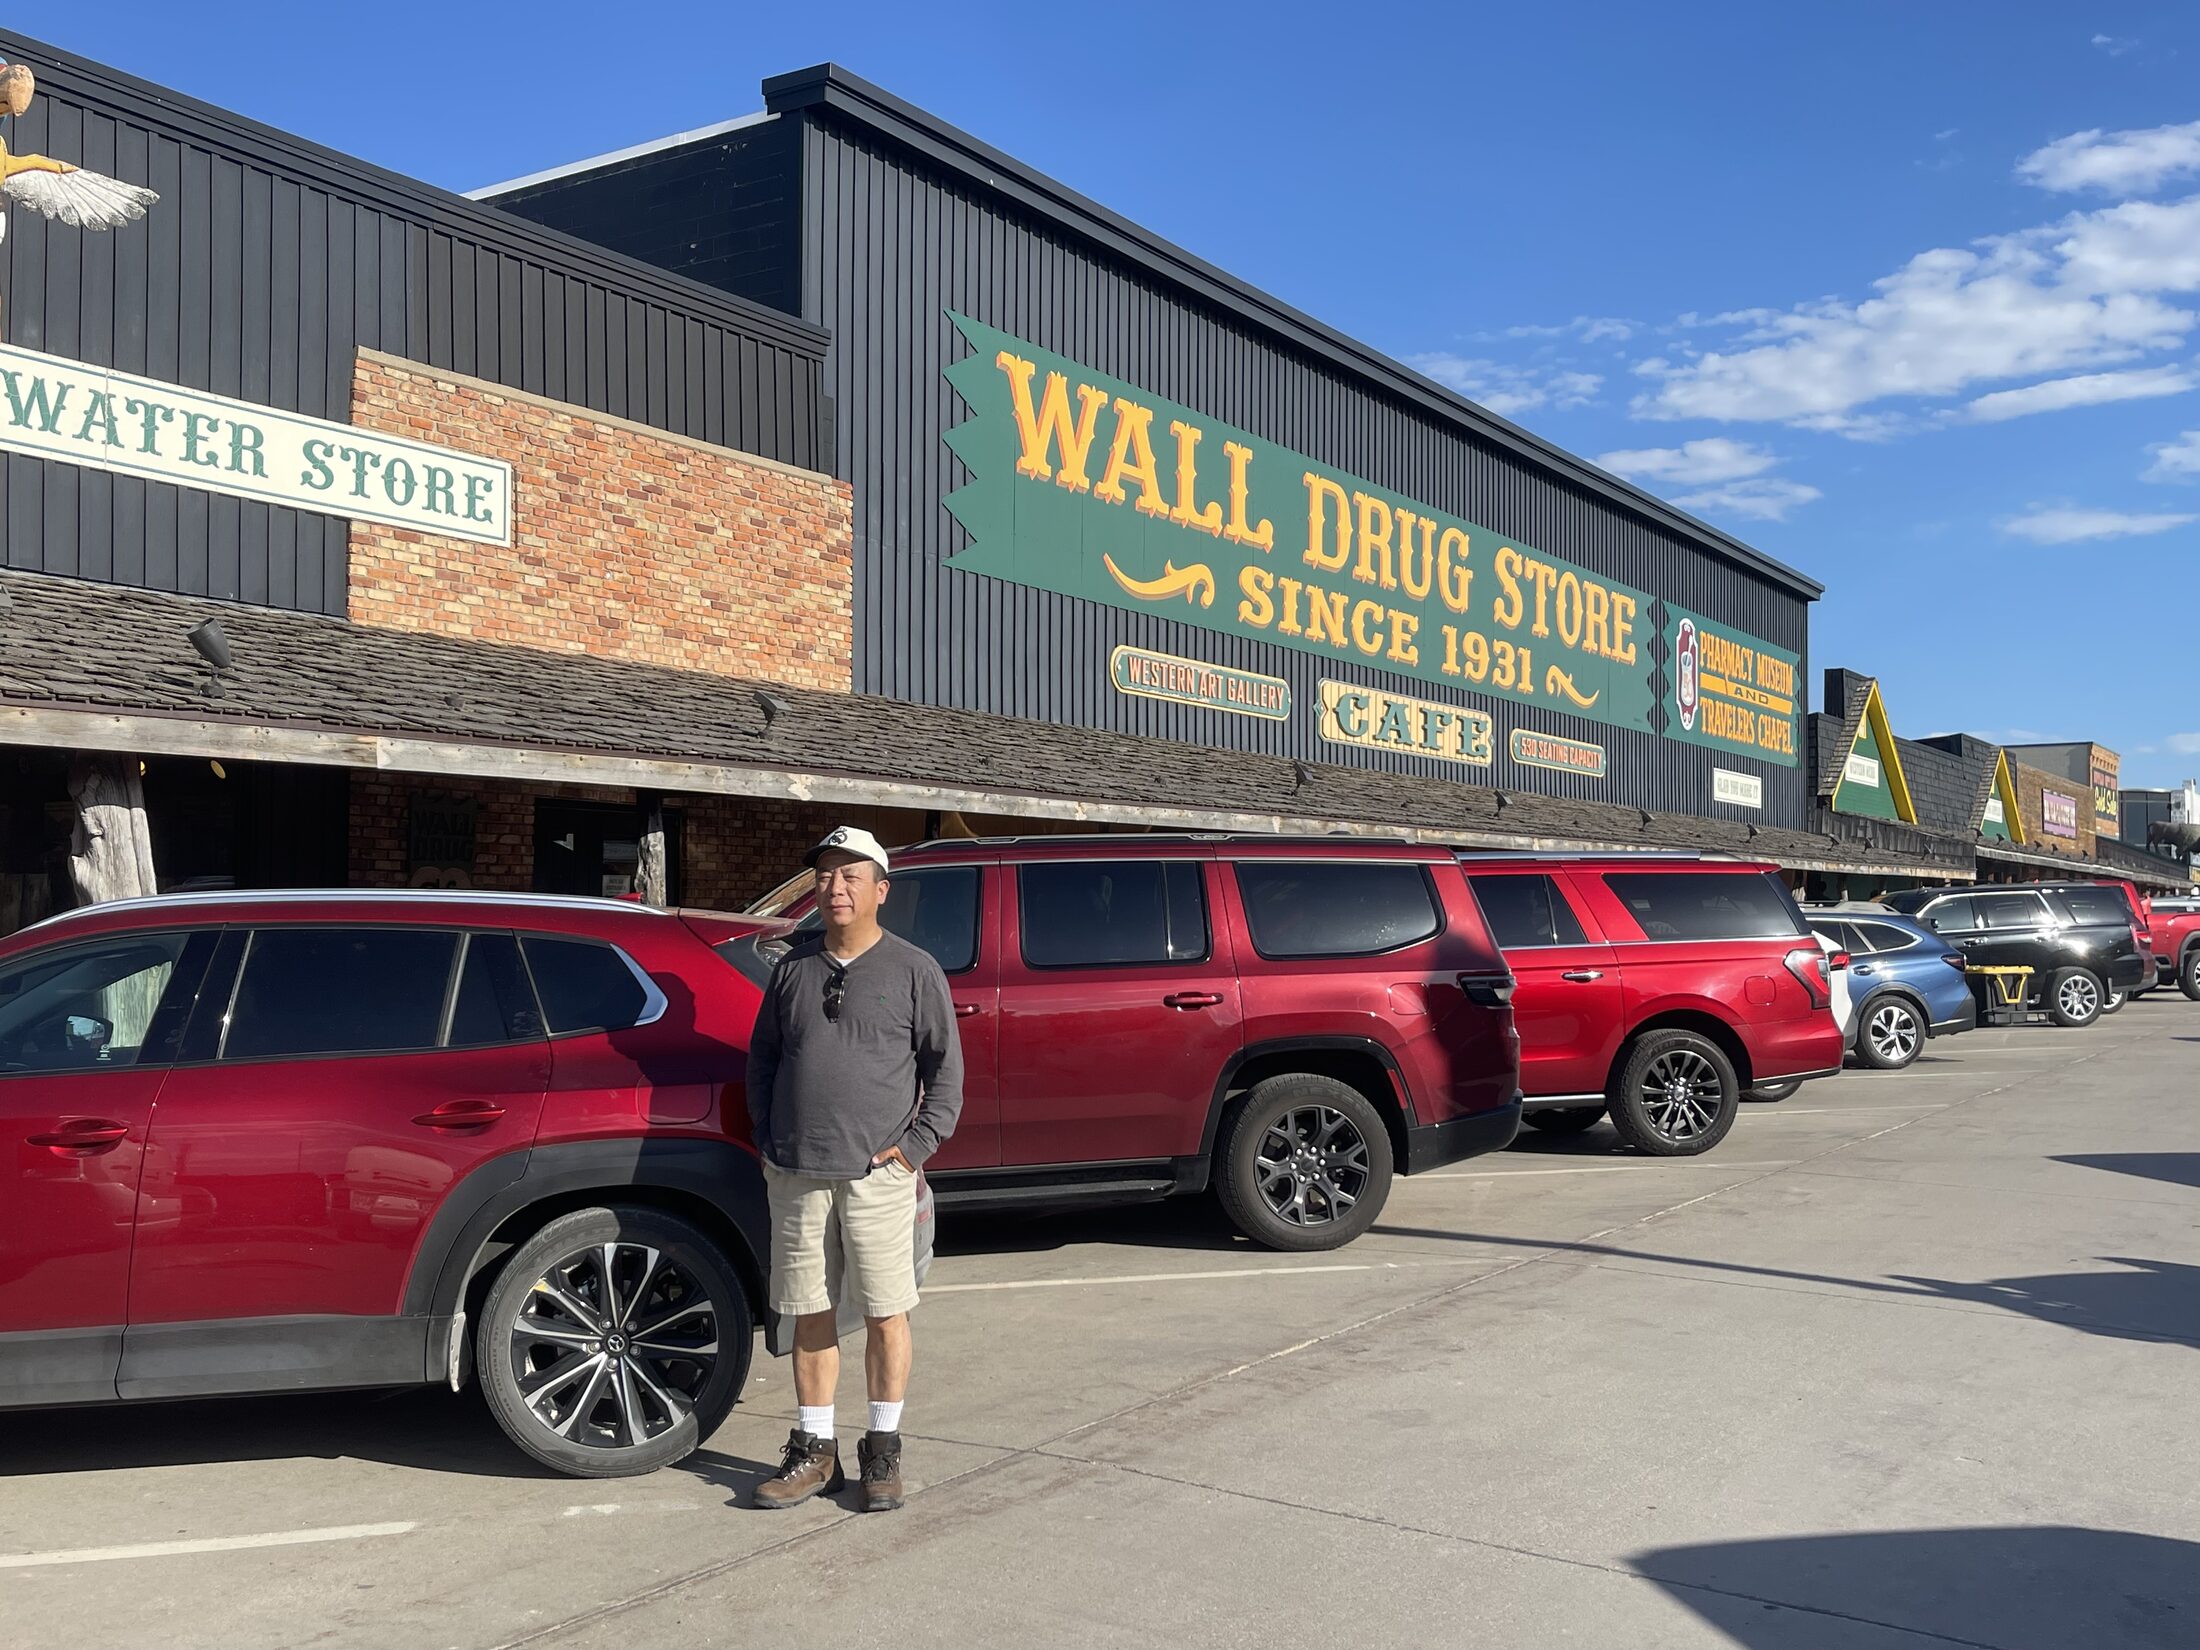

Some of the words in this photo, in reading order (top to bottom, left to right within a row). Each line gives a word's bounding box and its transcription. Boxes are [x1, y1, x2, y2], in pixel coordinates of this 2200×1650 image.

[0, 368, 269, 479] WATER
[300, 438, 494, 524] STORE
[996, 351, 1273, 553] WALL
[1302, 471, 1474, 614] DRUG
[1493, 546, 1637, 666] STORE
[1238, 565, 1419, 667] SINCE
[1441, 624, 1534, 695] 1931
[1700, 630, 1754, 683] PHARMACY
[1756, 652, 1794, 697] MUSEUM
[1127, 655, 1196, 694] WESTERN
[1198, 670, 1223, 699] ART
[1227, 676, 1284, 711] GALLERY
[1734, 685, 1769, 705] AND
[1333, 691, 1489, 759] CAFE
[1521, 737, 1537, 758] 530
[1538, 740, 1568, 763] SEATING
[1569, 747, 1602, 769] CAPACITY
[1700, 697, 1755, 745] TRAVELERS
[1757, 713, 1794, 755] CHAPEL
